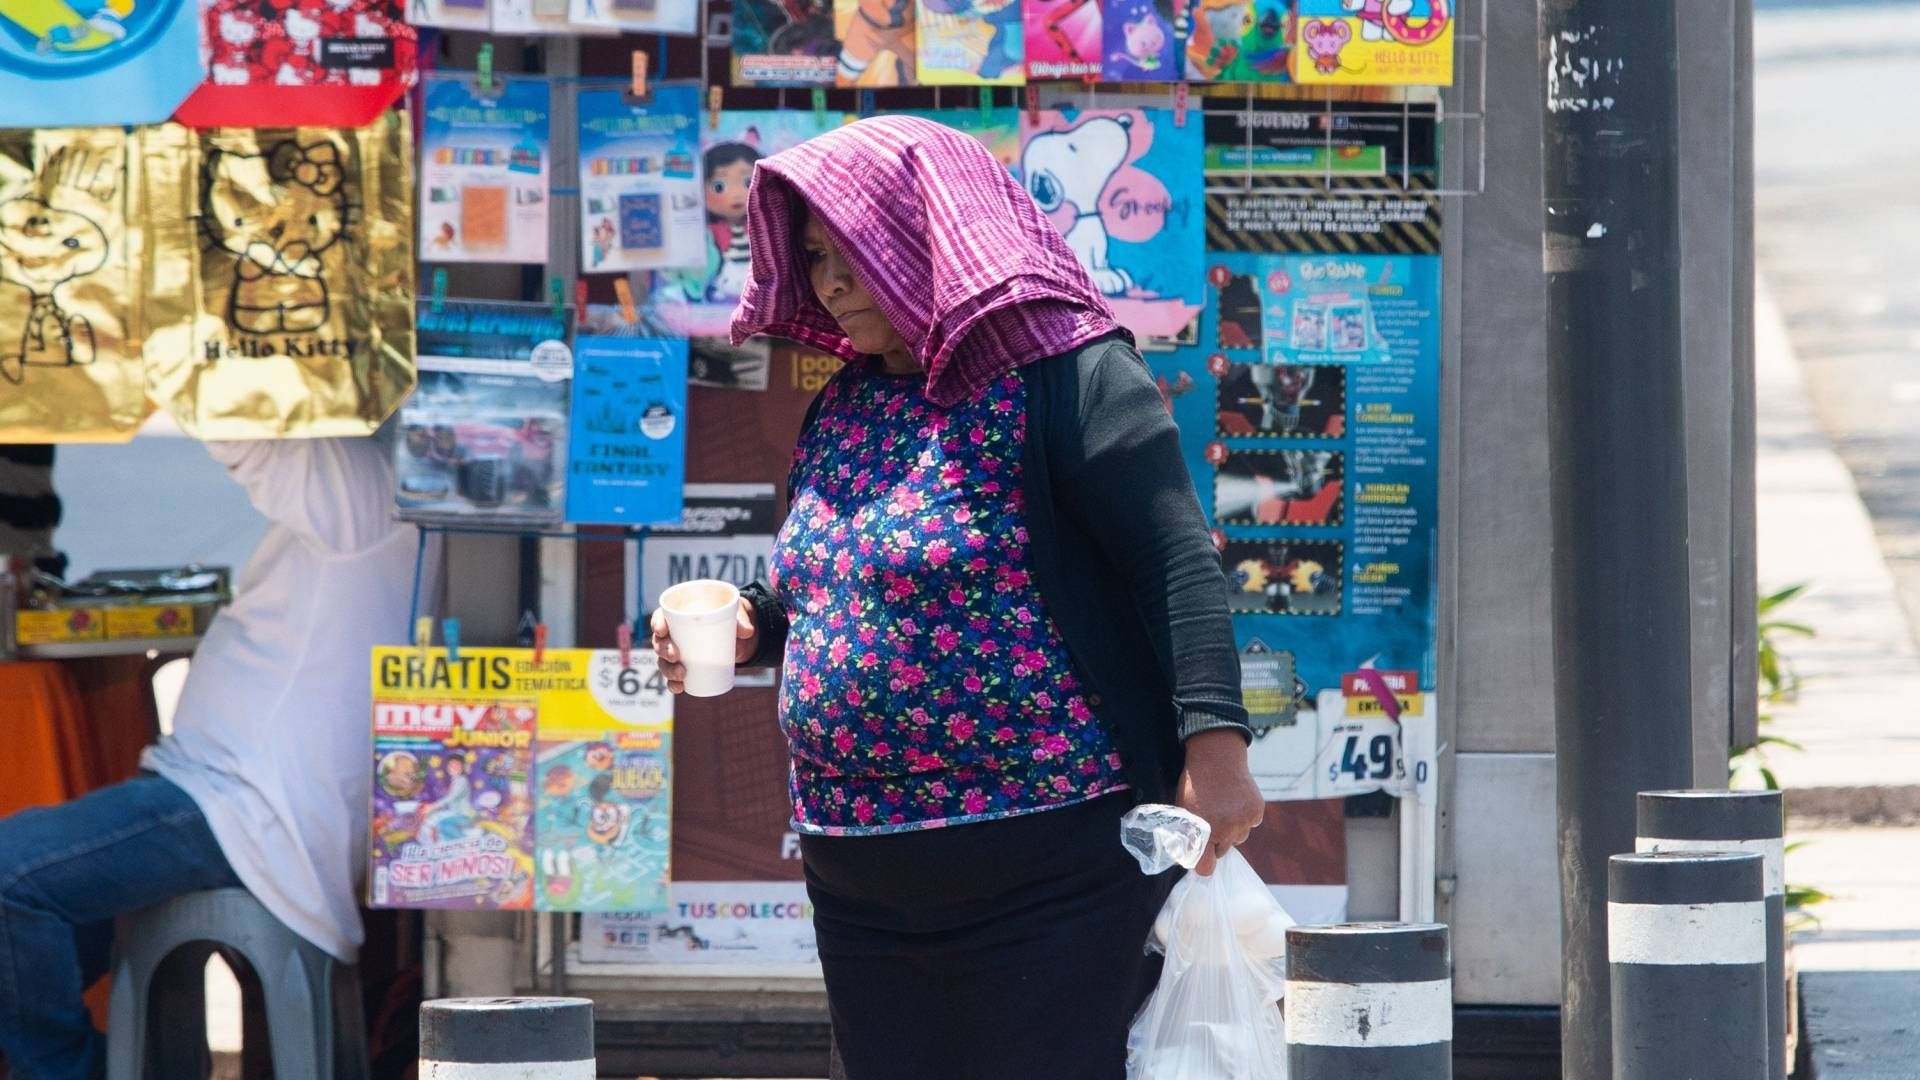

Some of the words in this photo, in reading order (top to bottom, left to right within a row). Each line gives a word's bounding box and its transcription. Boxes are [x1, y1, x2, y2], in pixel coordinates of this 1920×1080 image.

[204, 337, 276, 359] Hello
[284, 337, 359, 359] Kitty
[589, 444, 650, 458] FINAL
[572, 461, 670, 477] FANTASY
[668, 553, 769, 586] MAZDA
[380, 654, 512, 690] GRATIS
[375, 703, 491, 731] muy
[390, 862, 433, 884] SER
